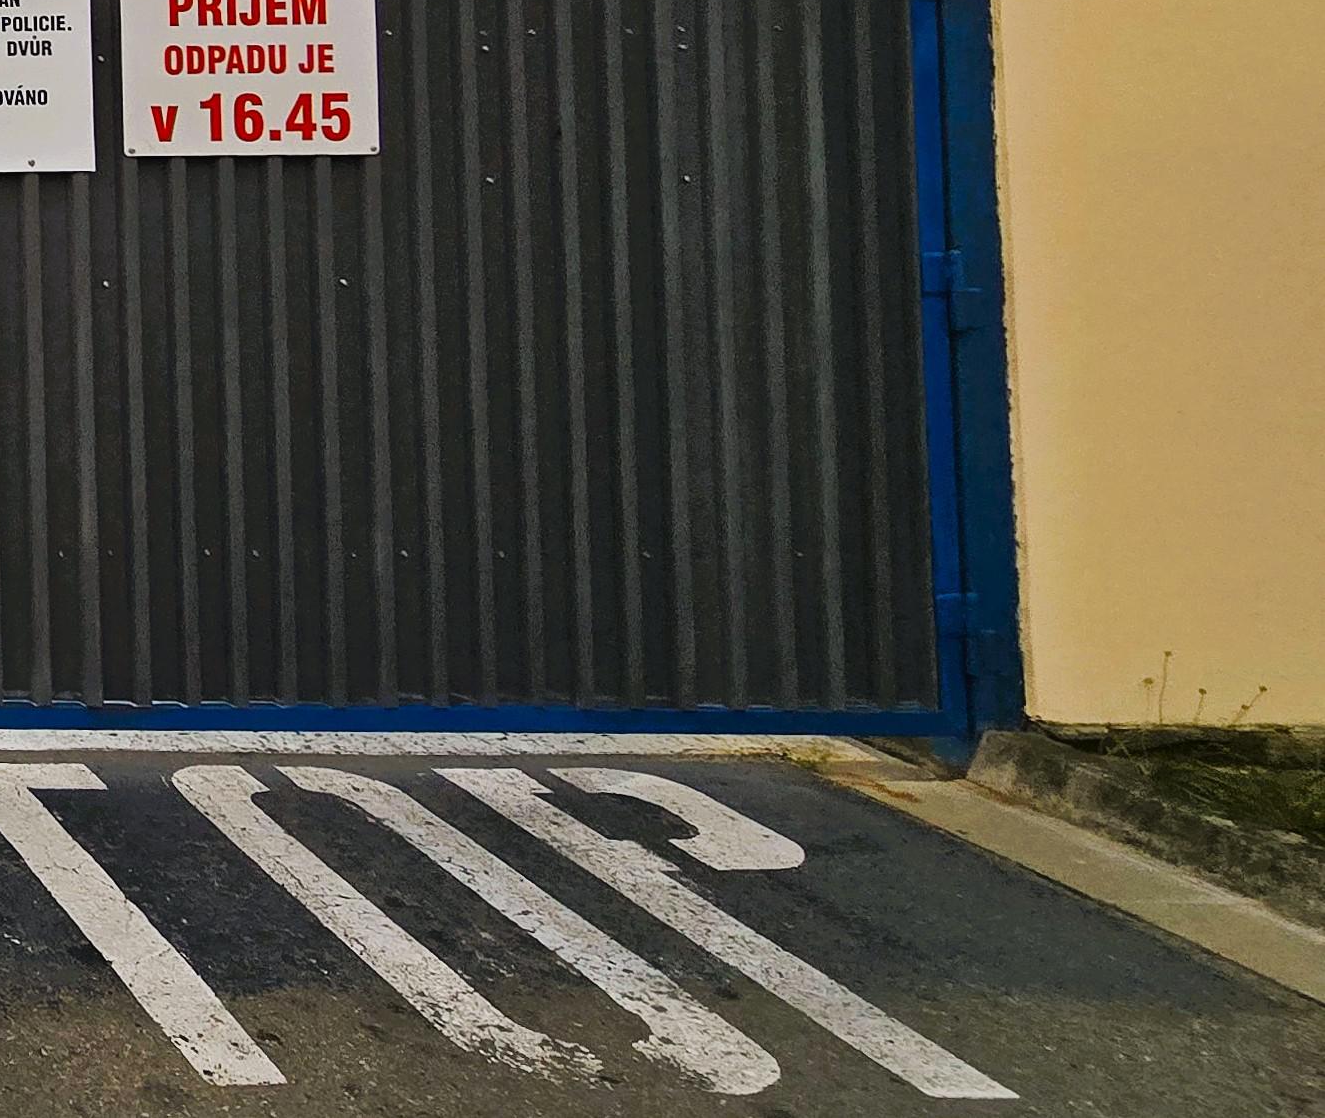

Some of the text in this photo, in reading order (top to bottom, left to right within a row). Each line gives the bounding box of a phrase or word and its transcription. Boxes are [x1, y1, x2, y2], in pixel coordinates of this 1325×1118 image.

[1, 15, 72, 32] POLICIE.
[7, 35, 53, 56] DVŮR
[164, 44, 335, 75] ODPADU JE
[150, 93, 351, 142] v 16.45
